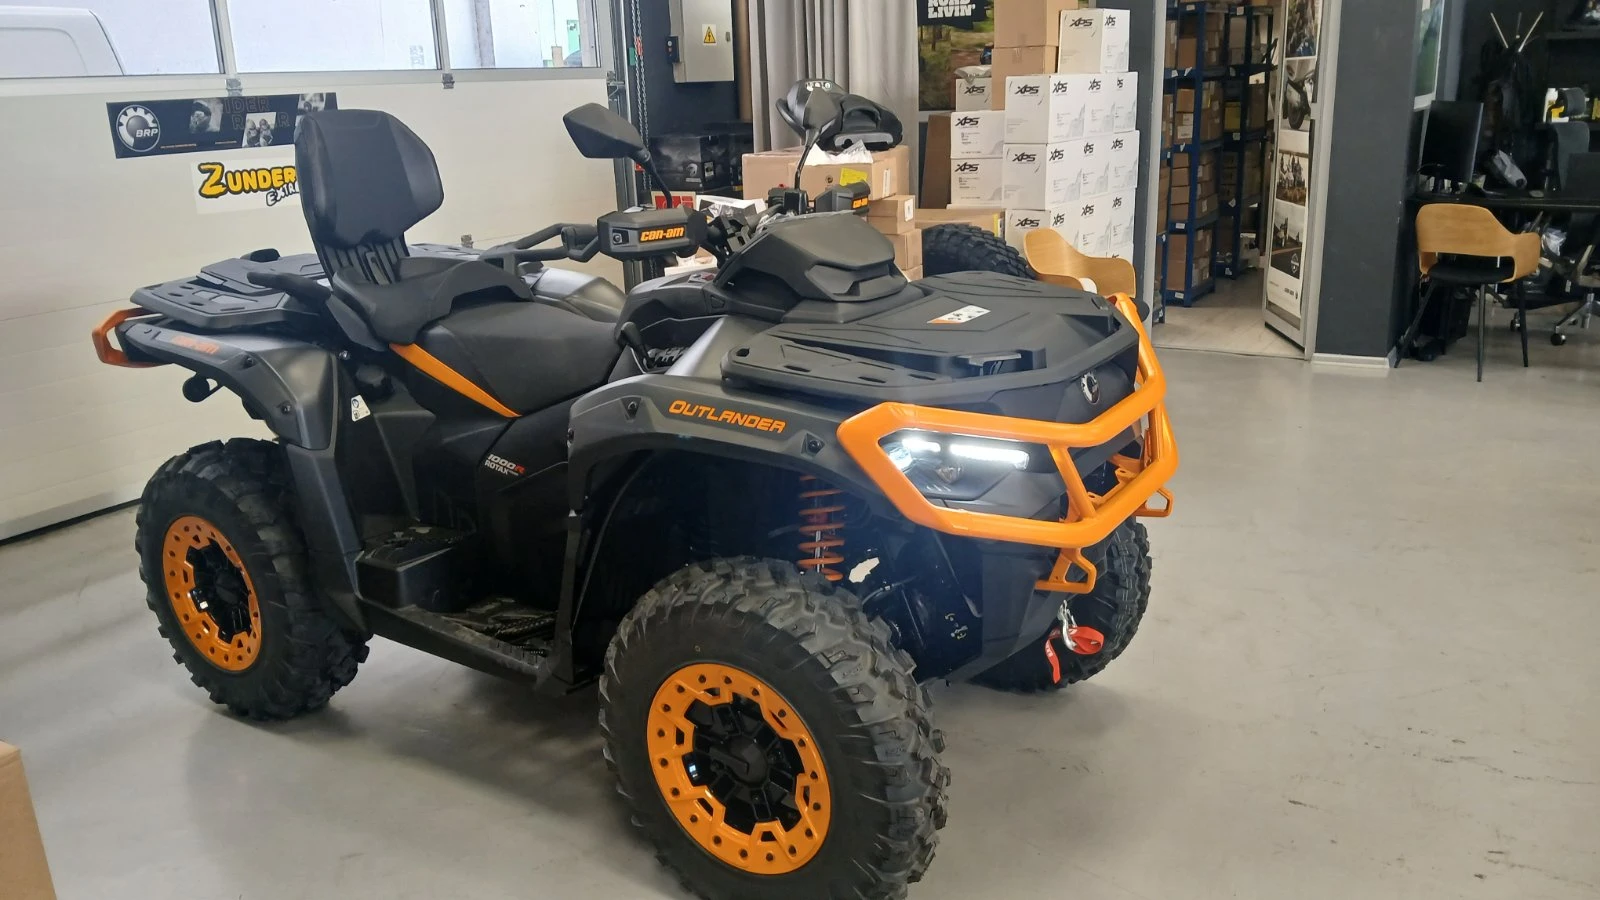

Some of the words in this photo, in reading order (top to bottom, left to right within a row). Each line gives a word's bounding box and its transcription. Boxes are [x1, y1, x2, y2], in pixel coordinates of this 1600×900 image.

[928, 4, 976, 18] LIVIN'
[1069, 17, 1094, 27] XPS
[1105, 15, 1116, 26] XPS
[1053, 80, 1068, 93] XPS
[1088, 78, 1101, 90] XPS
[1116, 77, 1124, 88] PS
[964, 85, 986, 94] XPS
[1015, 84, 1040, 94] XPS
[222, 96, 269, 114] IDER
[955, 116, 980, 126] XPS
[135, 128, 159, 138] BRP
[1111, 138, 1124, 150] XPS
[1012, 152, 1036, 162] XPS
[1049, 148, 1065, 161] XPS
[955, 162, 979, 172] XPS
[198, 162, 297, 198] ZUNDER
[1081, 204, 1094, 216] XPS
[1015, 217, 1040, 227] XPS
[1053, 213, 1065, 226] XPS
[640, 226, 685, 242] can-am
[668, 399, 786, 433] OUTLANDER
[484, 459, 509, 475] ROTAX
